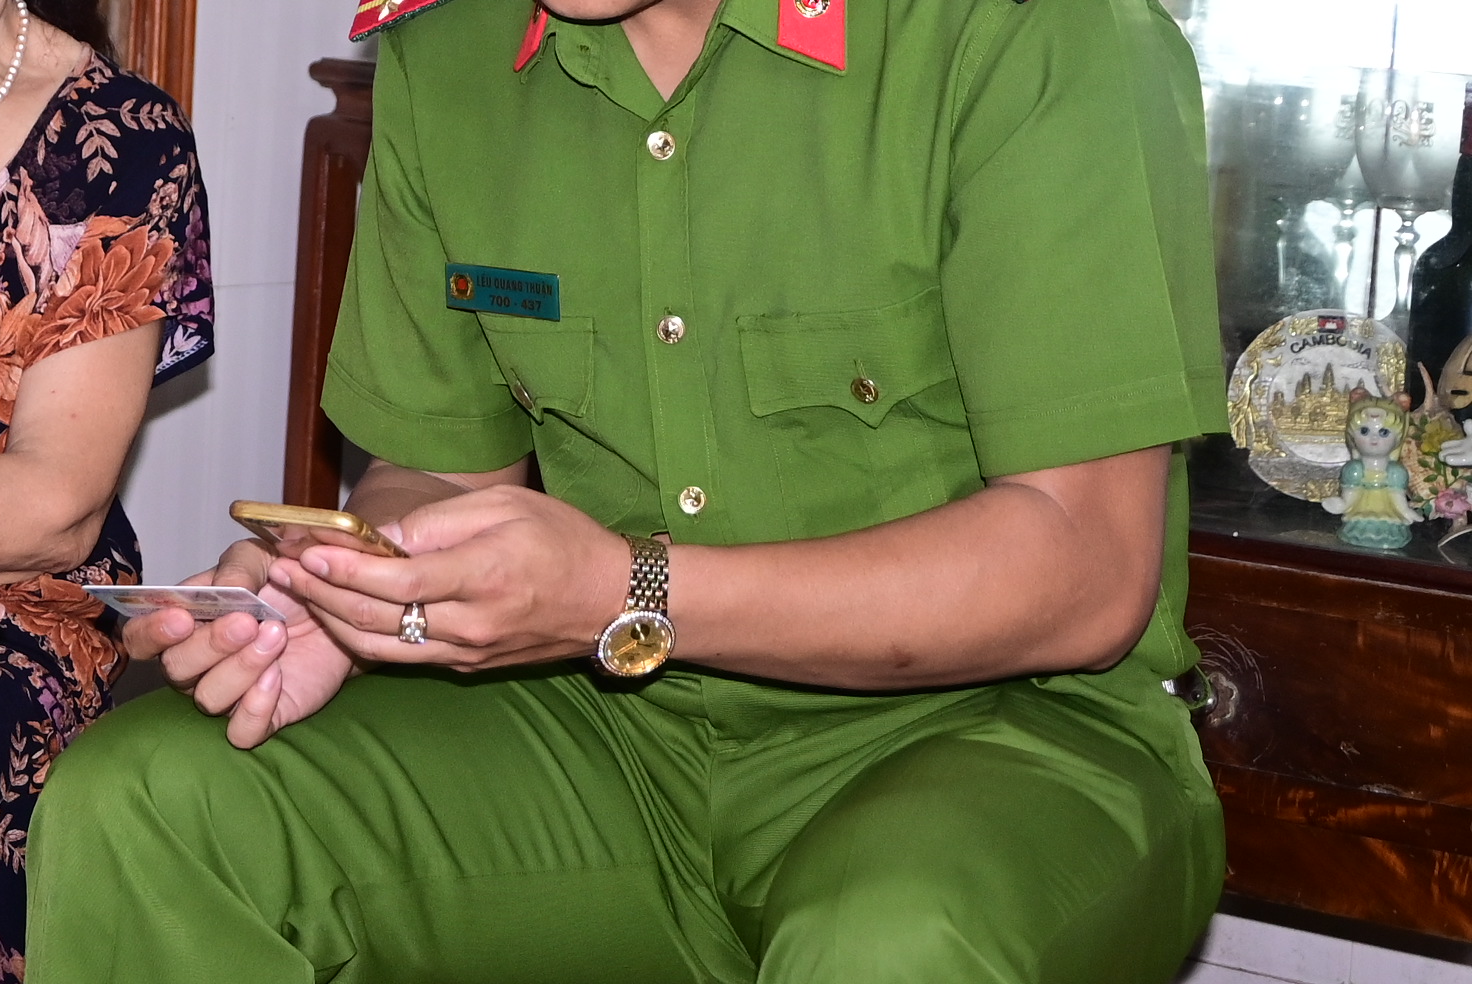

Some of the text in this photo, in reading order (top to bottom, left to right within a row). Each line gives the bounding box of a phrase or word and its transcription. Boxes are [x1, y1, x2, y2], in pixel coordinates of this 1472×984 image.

[494, 278, 523, 292] QUANG
[489, 295, 511, 307] 700
[1290, 334, 1372, 359] CAMBODIA
